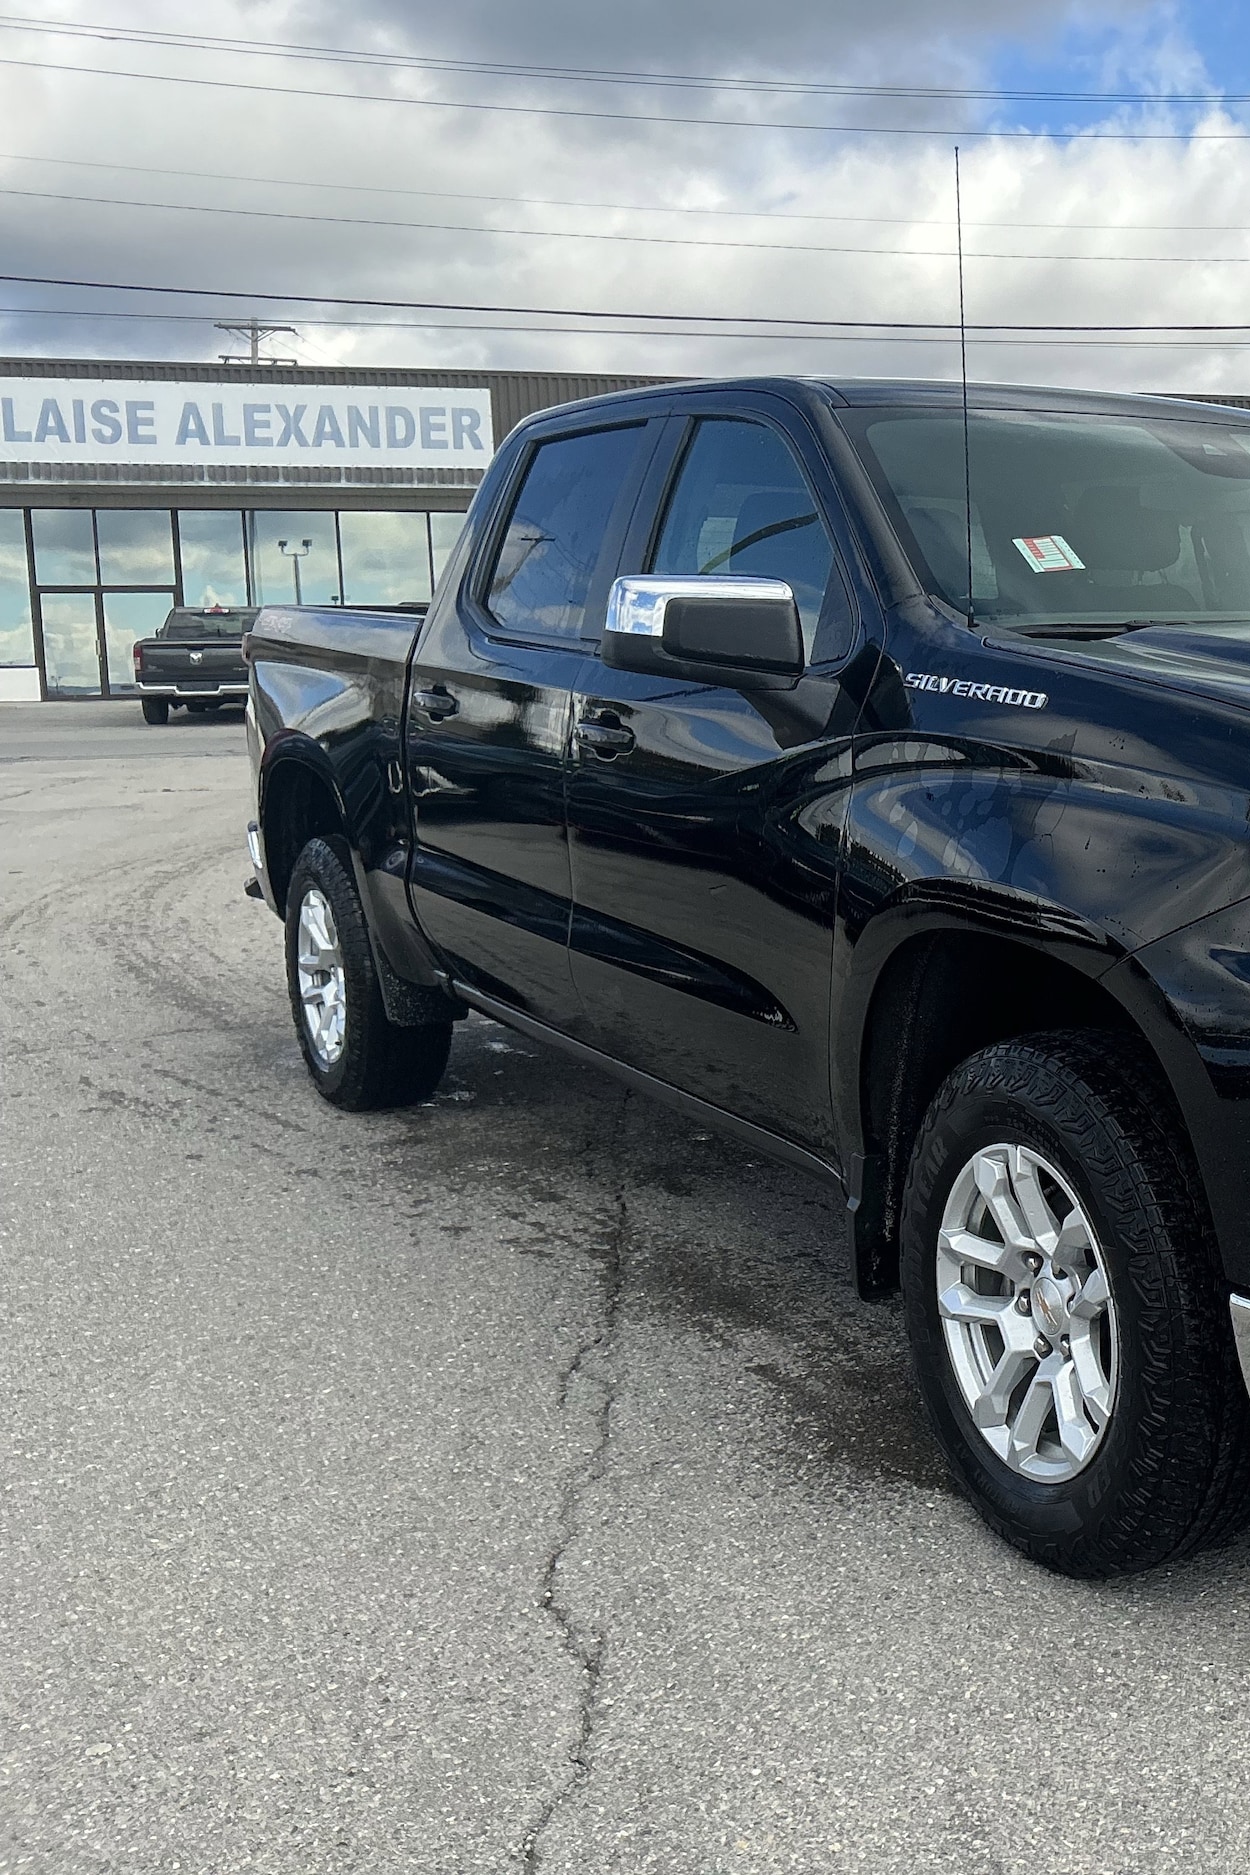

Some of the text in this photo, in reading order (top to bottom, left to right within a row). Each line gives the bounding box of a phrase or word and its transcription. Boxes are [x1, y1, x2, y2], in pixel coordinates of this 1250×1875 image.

[0, 397, 484, 450] LAISE ALEXANDER
[903, 672, 1049, 709] SILVERADO
